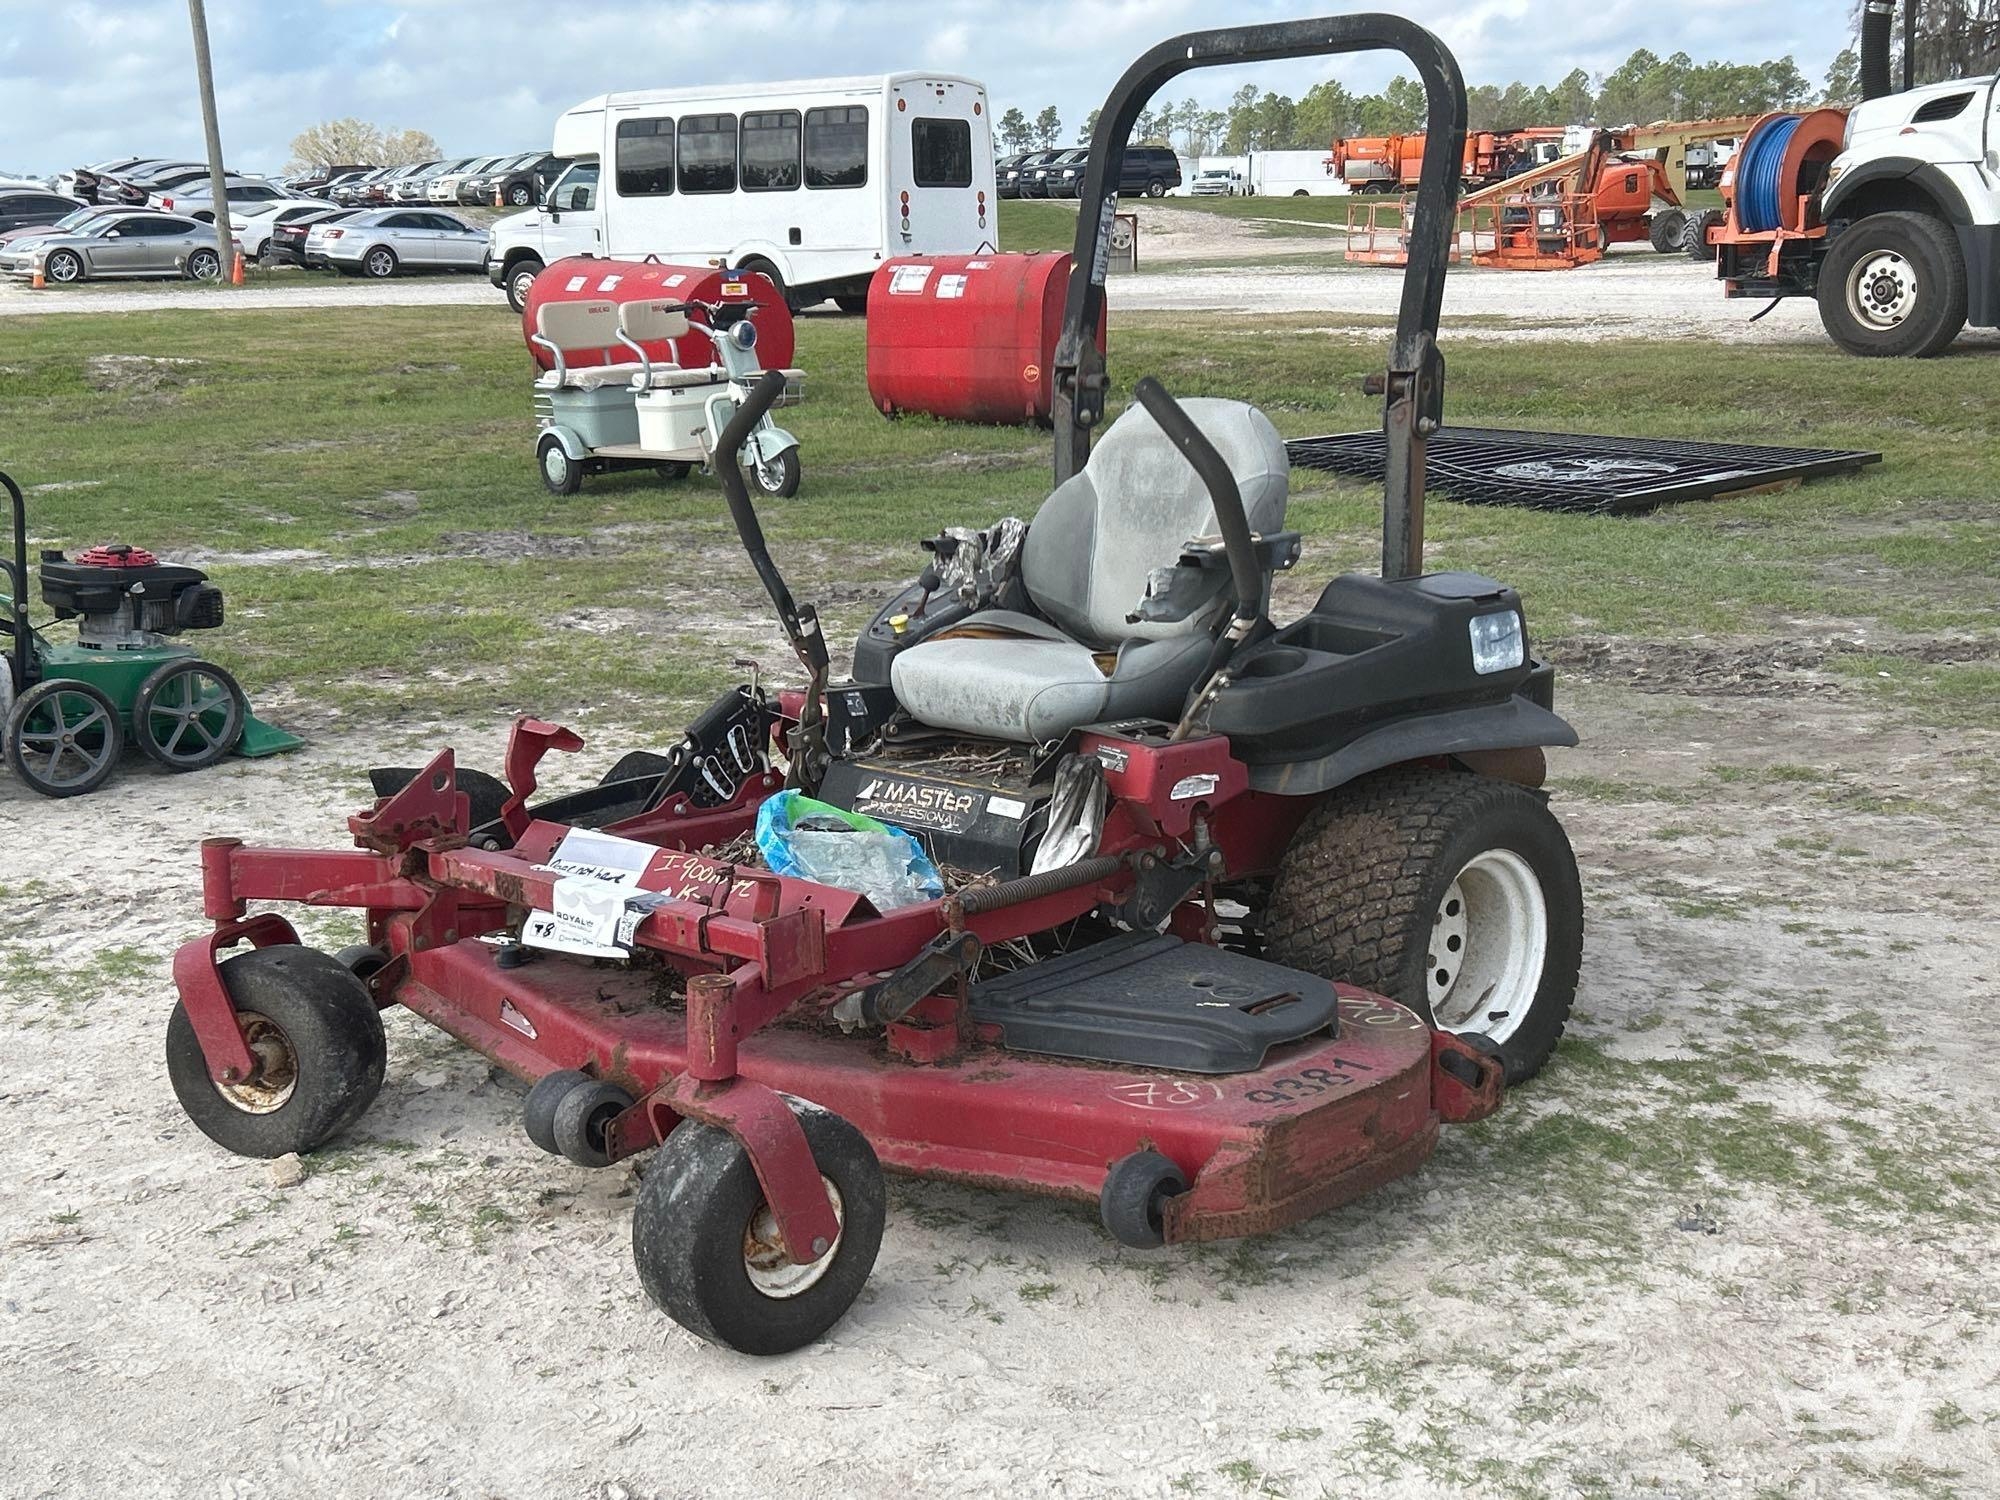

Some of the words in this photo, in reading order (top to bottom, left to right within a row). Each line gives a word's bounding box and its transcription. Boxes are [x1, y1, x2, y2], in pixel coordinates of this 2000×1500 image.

[883, 782, 974, 814] MASTER
[556, 910, 586, 927] ROYAL
[1113, 1080, 1201, 1106] 78
[1243, 1056, 1374, 1106] 9381
